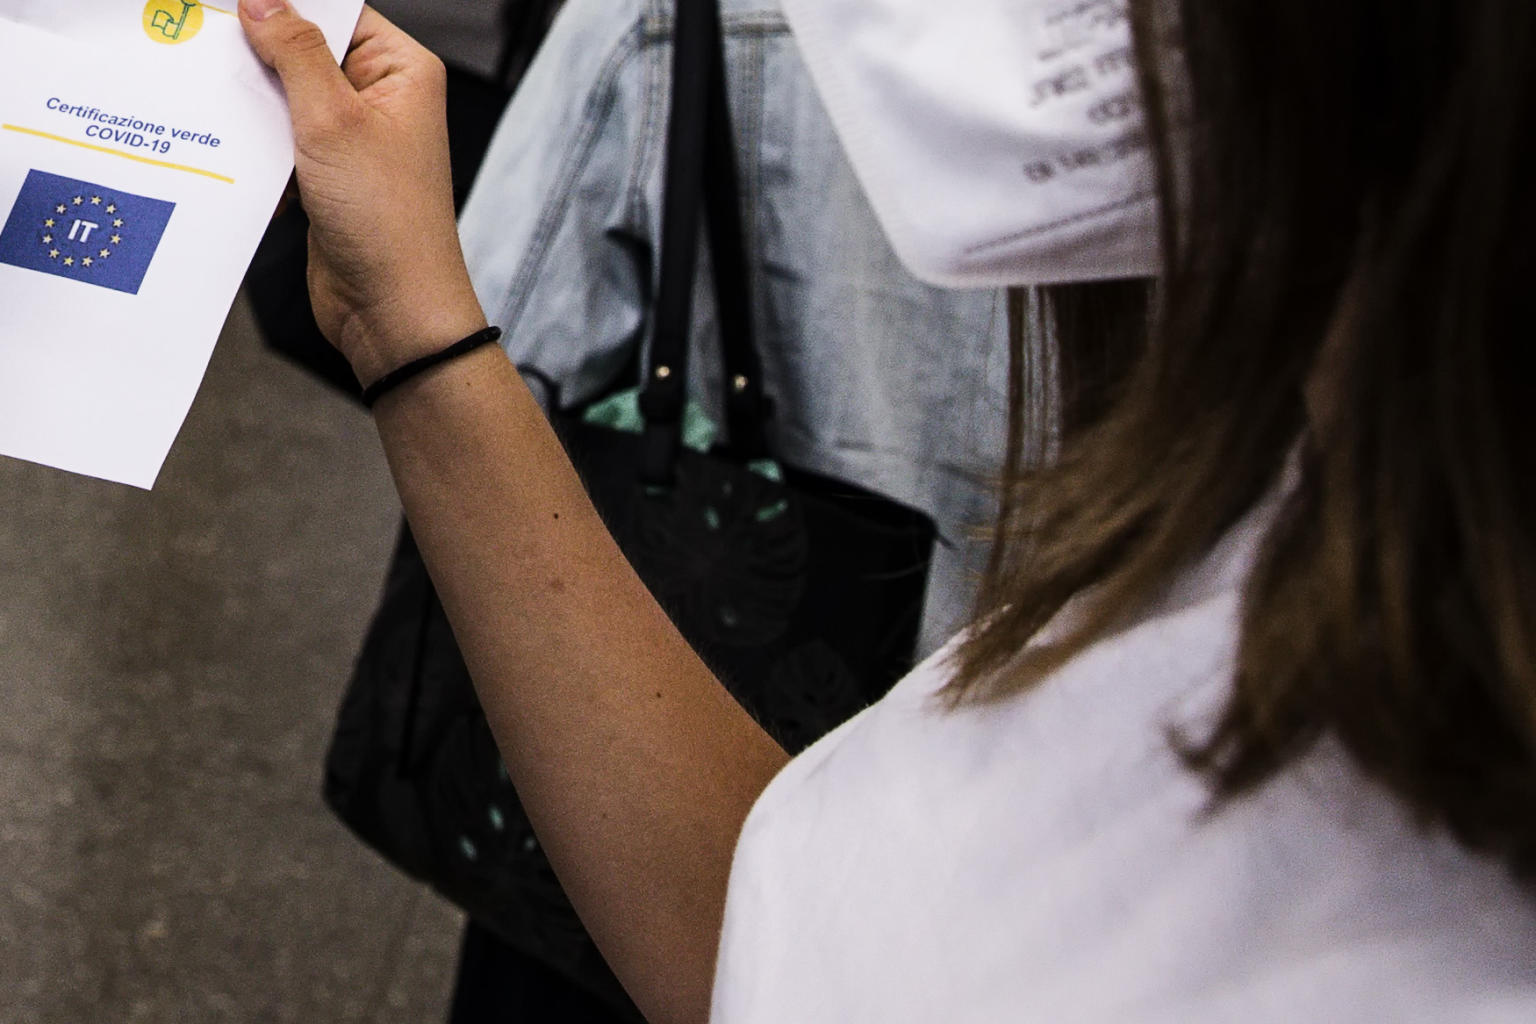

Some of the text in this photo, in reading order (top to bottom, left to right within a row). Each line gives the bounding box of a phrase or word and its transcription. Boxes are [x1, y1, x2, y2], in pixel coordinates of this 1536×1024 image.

[46, 97, 221, 148] Certificazione verde
[85, 125, 171, 154] COVID-19
[68, 219, 99, 243] IT
